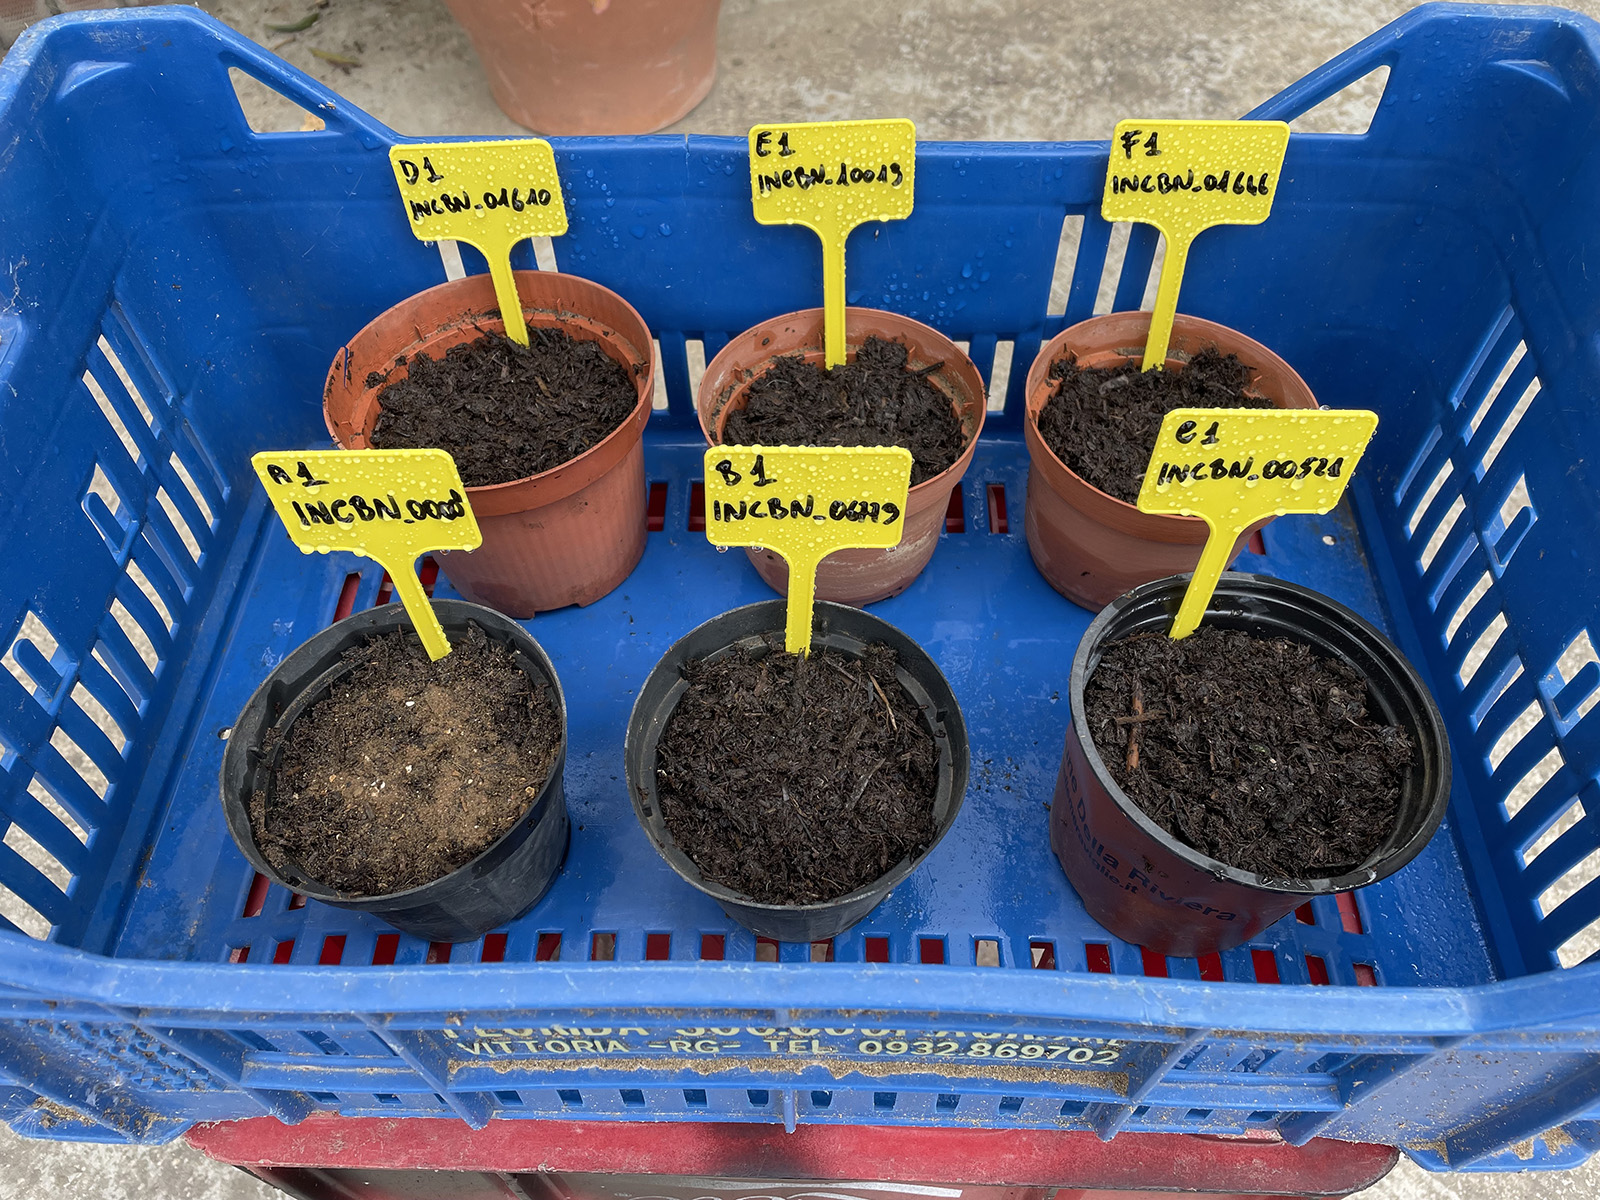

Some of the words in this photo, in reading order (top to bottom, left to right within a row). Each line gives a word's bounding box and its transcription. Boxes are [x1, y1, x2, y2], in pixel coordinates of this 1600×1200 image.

[755, 131, 796, 158] E1
[1119, 130, 1163, 160] F1
[398, 156, 445, 186] D1
[1076, 796, 1120, 871] Della
[1128, 867, 1237, 922] Riviera
[456, 1039, 630, 1056] VITTORIA
[857, 1039, 1120, 1066] 0932.869702
